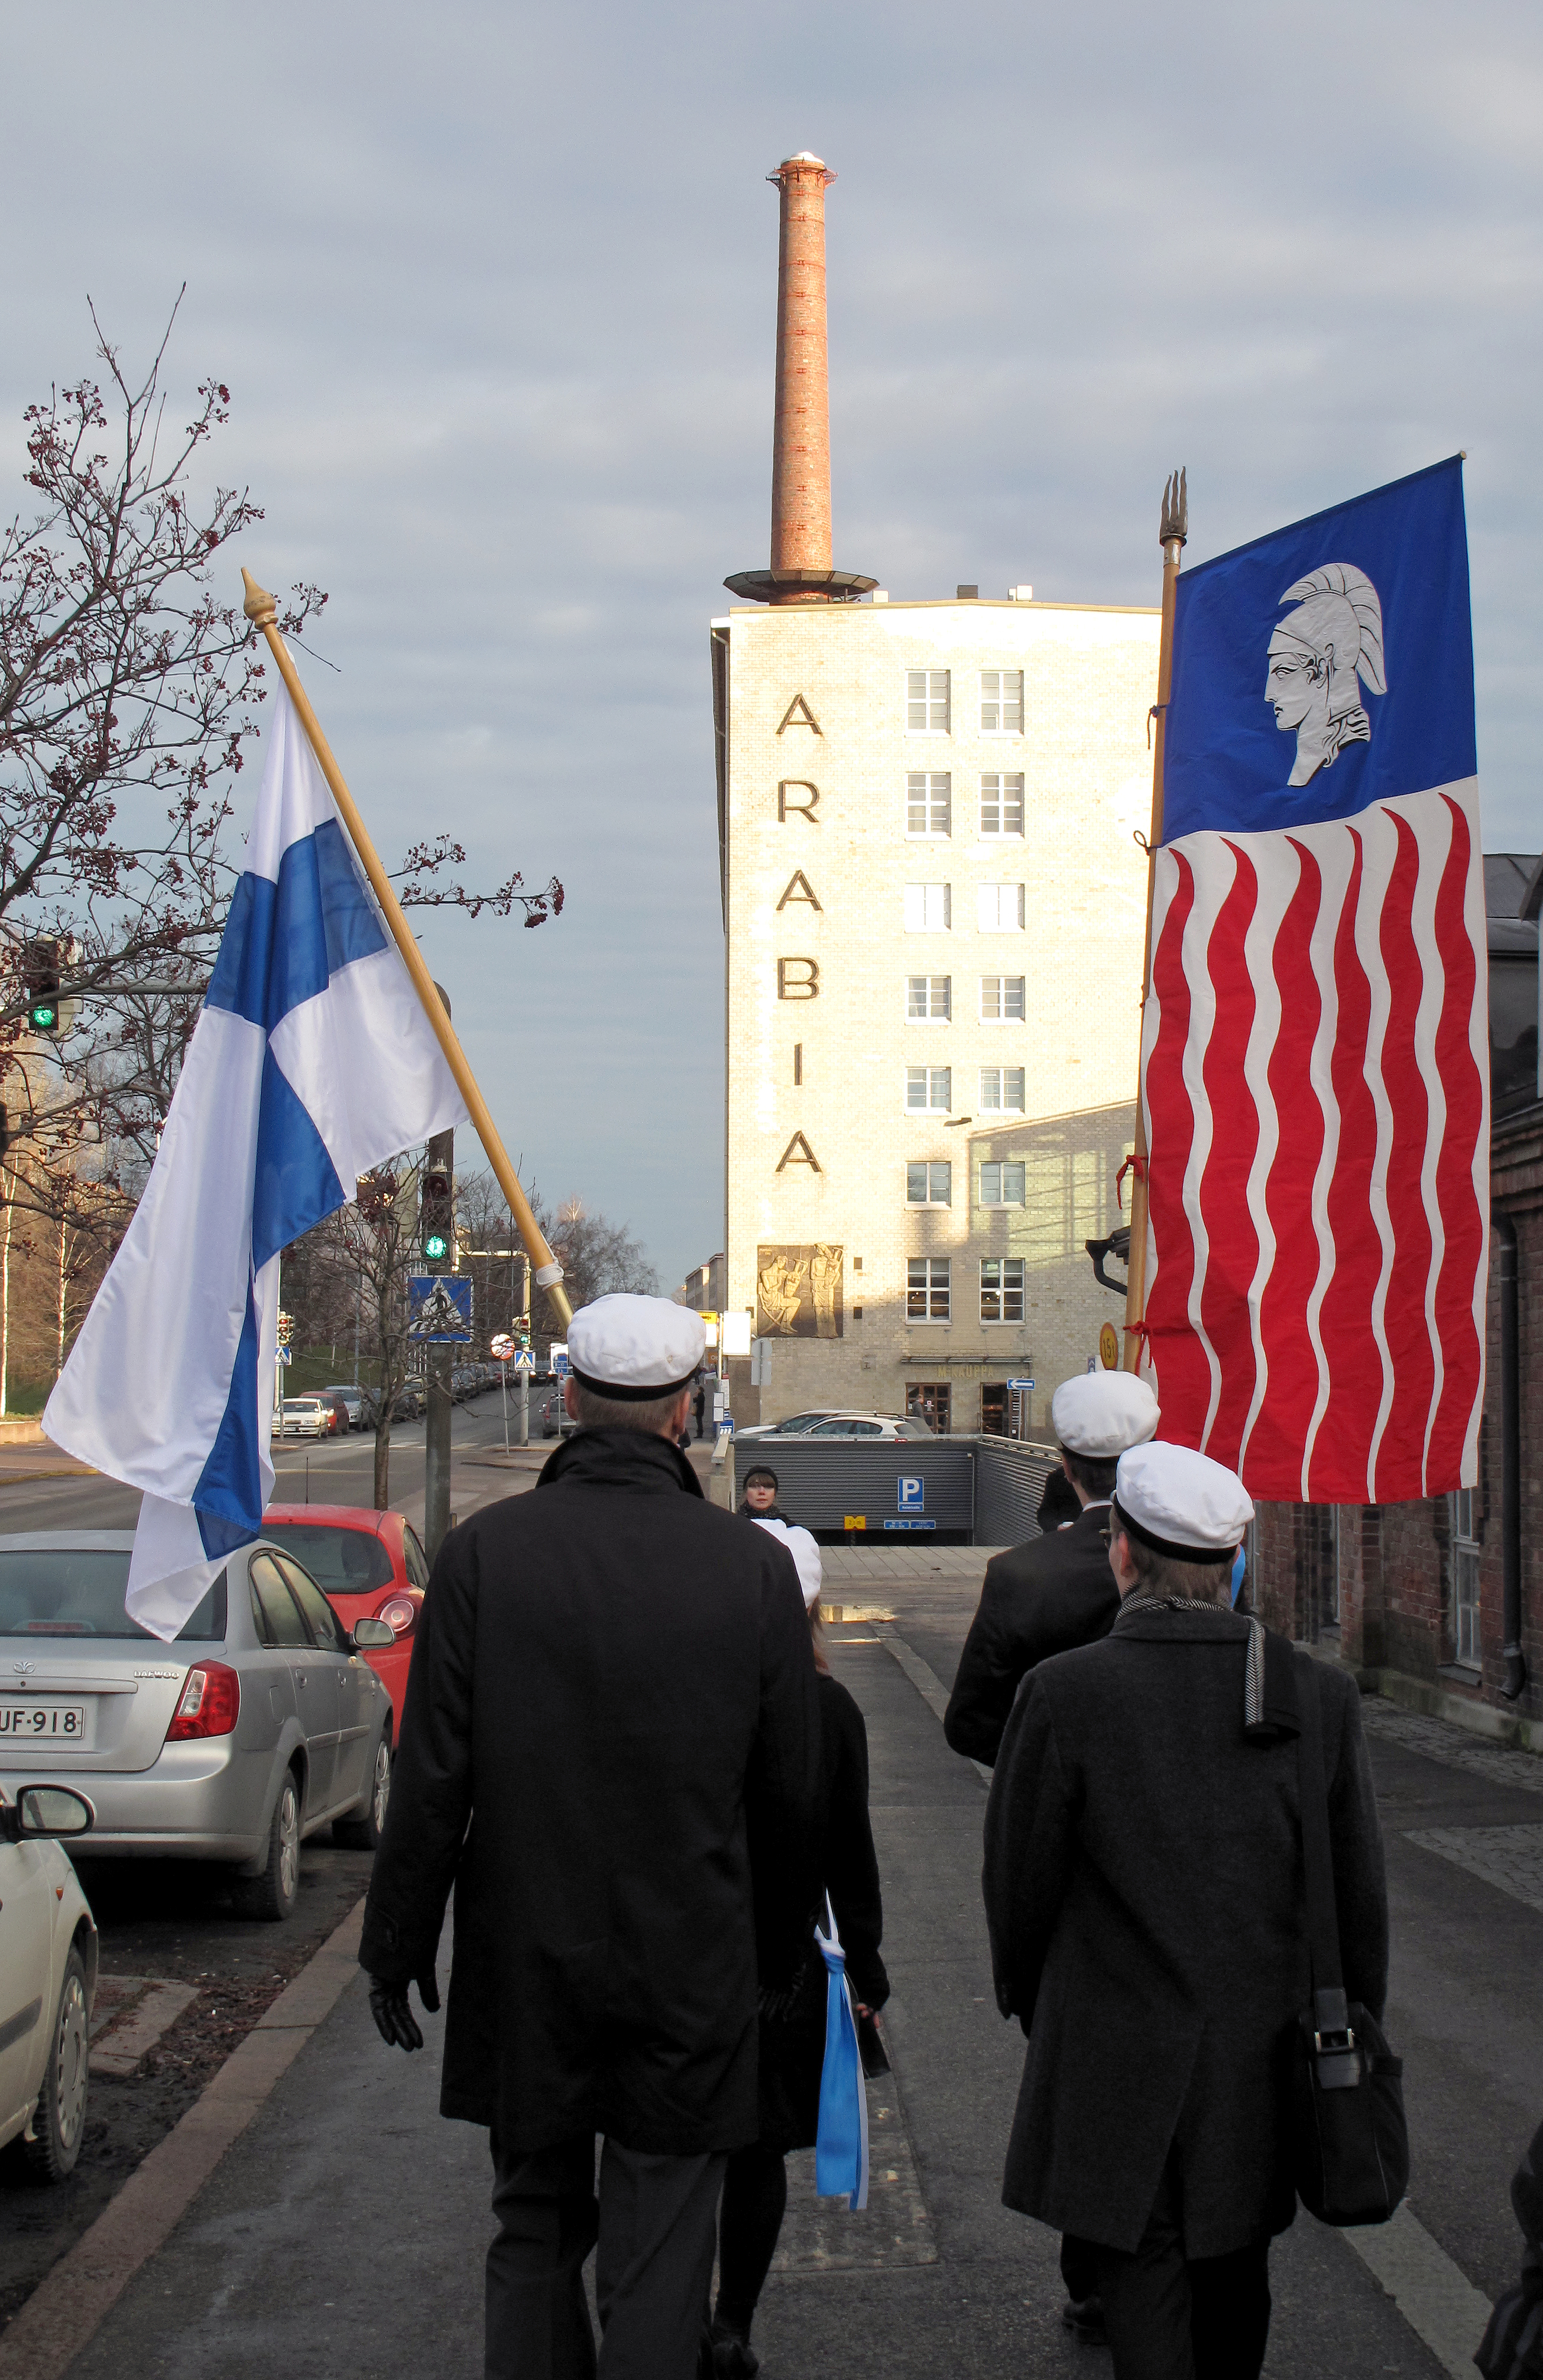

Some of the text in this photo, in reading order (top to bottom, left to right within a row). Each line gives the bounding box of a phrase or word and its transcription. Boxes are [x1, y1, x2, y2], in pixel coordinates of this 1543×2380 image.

[775, 693, 824, 1173] ARABIA
[902, 1478, 920, 1502] P
[134, 1670, 180, 1679] DAEWOO
